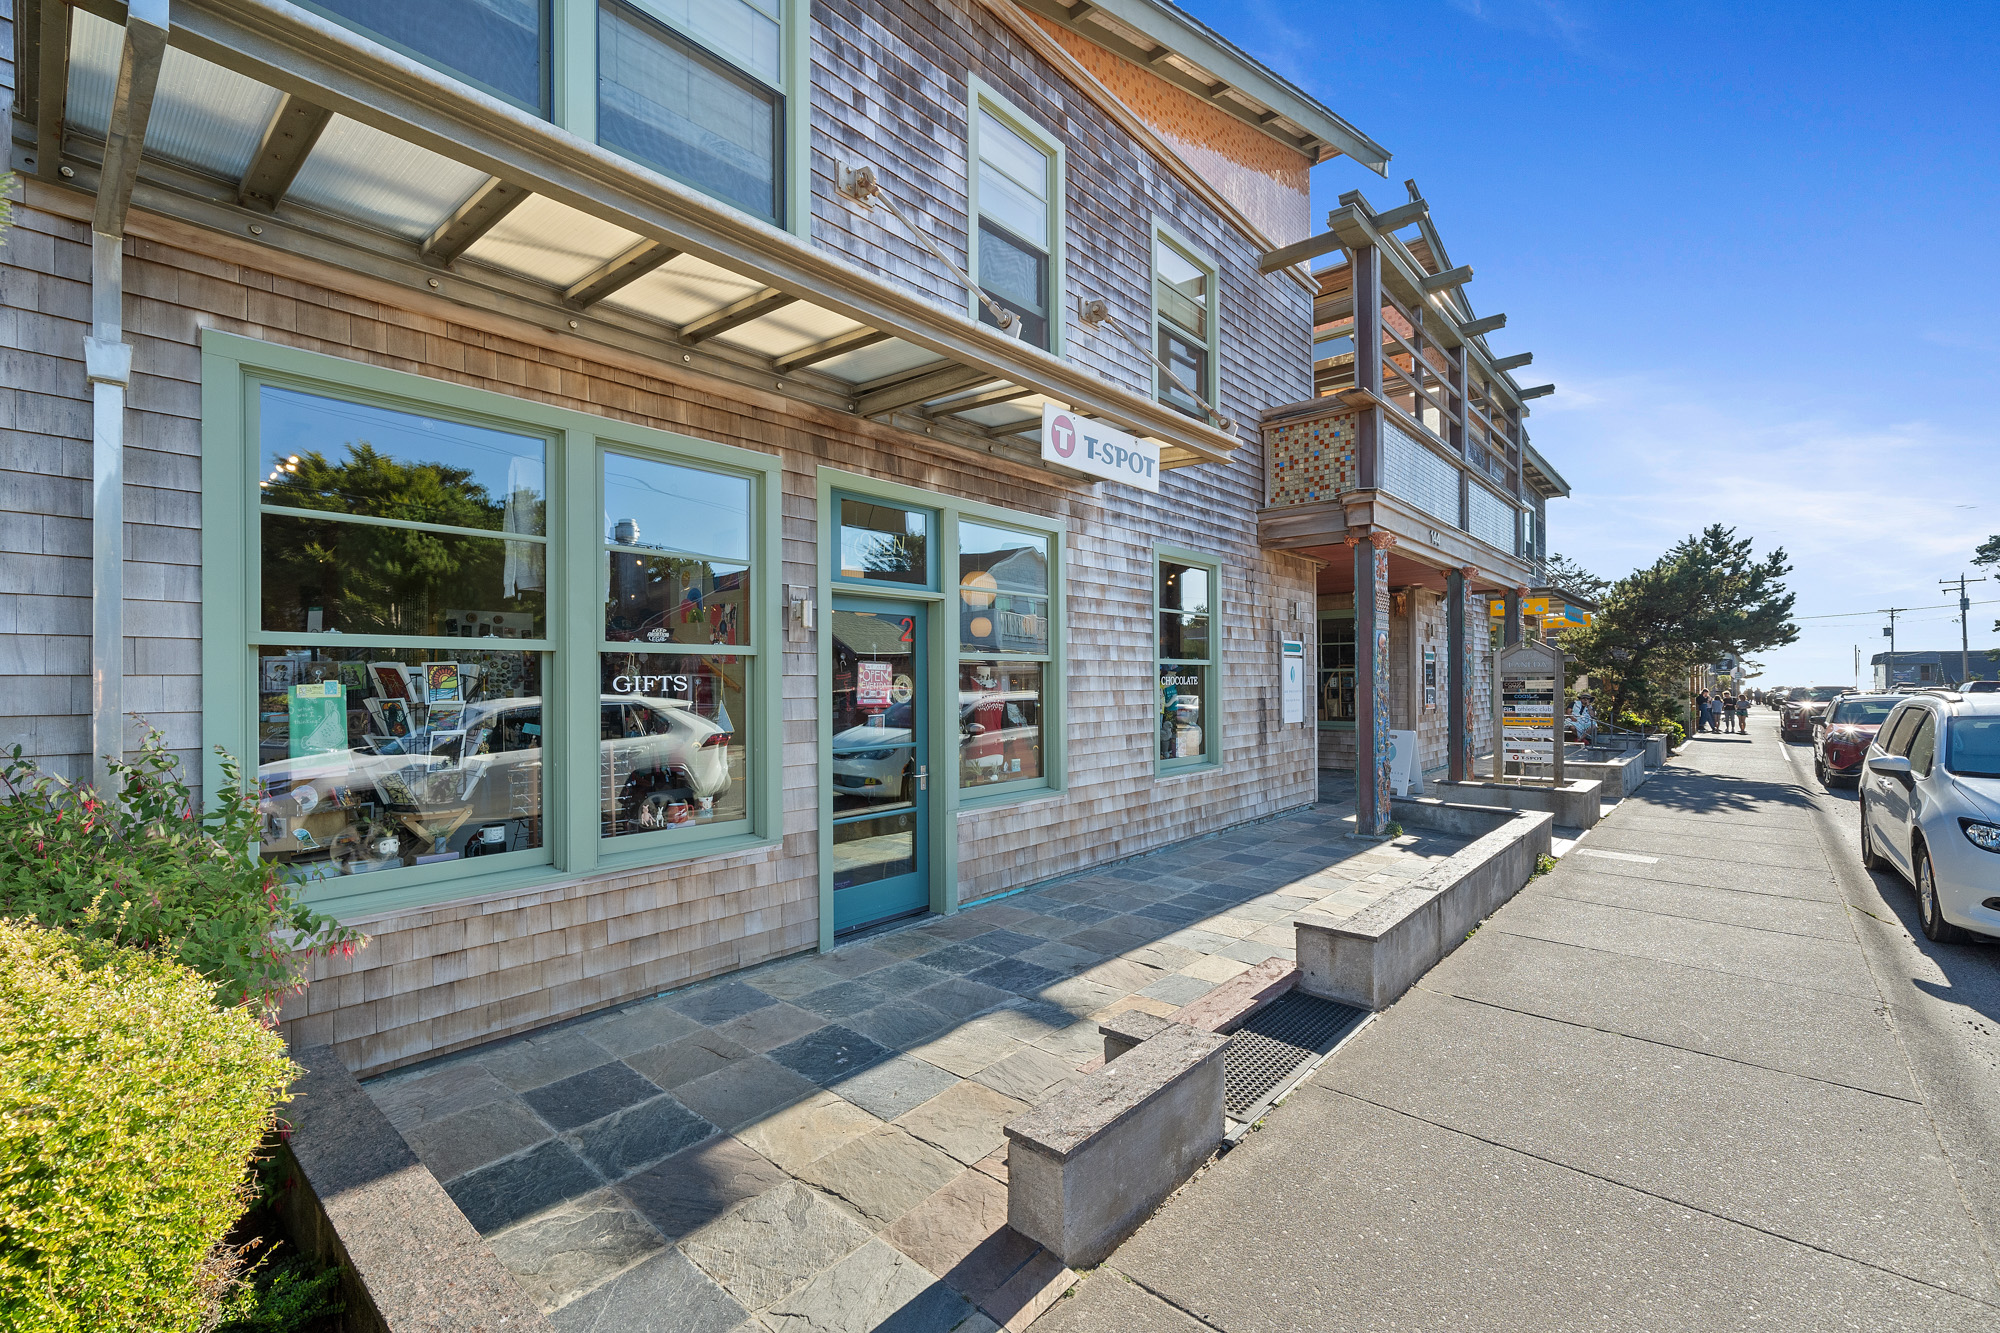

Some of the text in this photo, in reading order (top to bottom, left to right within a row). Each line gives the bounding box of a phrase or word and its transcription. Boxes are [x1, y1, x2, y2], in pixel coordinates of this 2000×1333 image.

[1083, 435, 1156, 478] T-SPOT
[901, 618, 914, 642] 2
[612, 675, 688, 693] GIFTS
[862, 669, 889, 682] OPEN
[1160, 676, 1199, 686] CHOCOLATE
